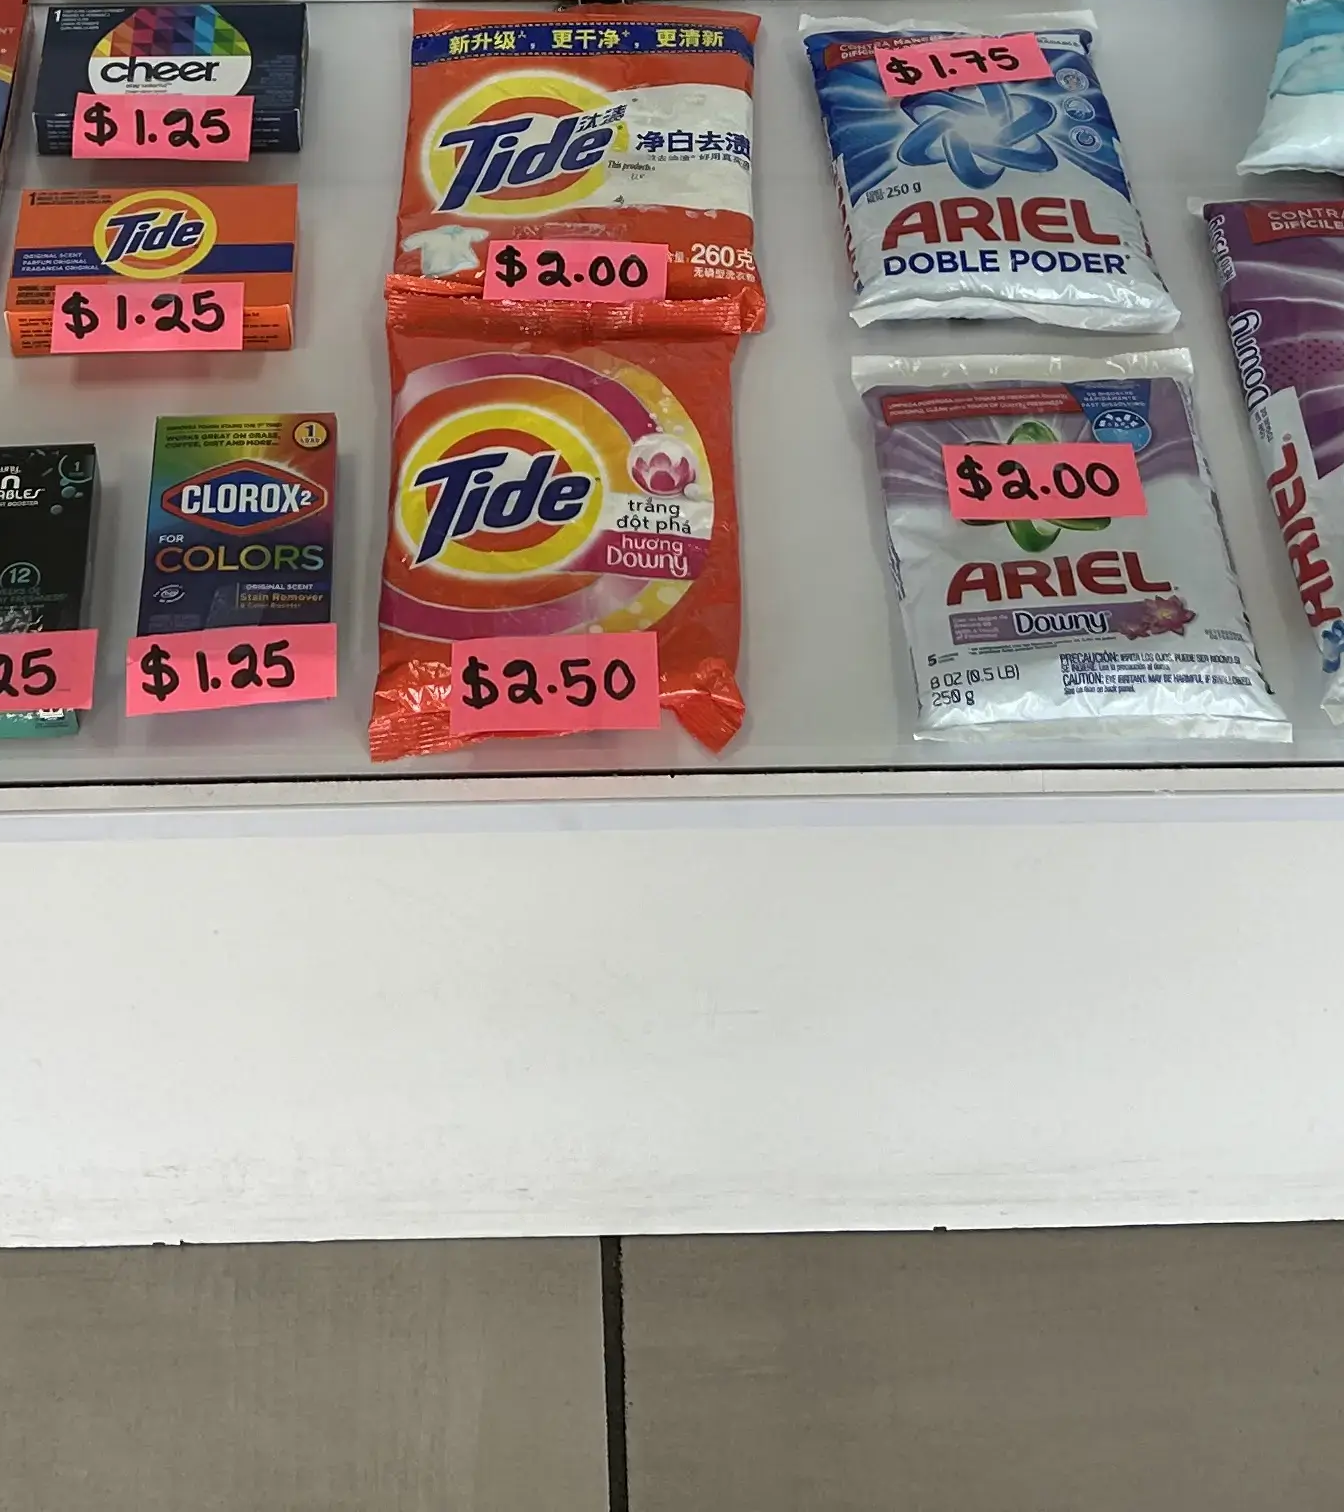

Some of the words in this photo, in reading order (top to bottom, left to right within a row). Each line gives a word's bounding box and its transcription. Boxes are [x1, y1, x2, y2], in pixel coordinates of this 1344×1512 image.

[101, 57, 217, 82] cheer
[886, 46, 1019, 86] $1.75
[83, 102, 231, 149] $1.25
[436, 116, 613, 213] Tide
[102, 211, 204, 264] Tide
[882, 196, 1120, 250] ARIEL
[495, 245, 649, 287] $2.00
[884, 249, 1000, 276] DOBLE
[1011, 251, 1127, 274] PODER
[61, 290, 225, 339] $1.25
[956, 454, 1120, 501] $2.00
[413, 452, 591, 564] Tide
[616, 514, 649, 531] đột
[656, 516, 692, 535] phá
[628, 497, 680, 518] trắng
[159, 535, 184, 543] FOR
[622, 535, 683, 555] hương
[1269, 441, 1344, 628] ARIEL
[155, 545, 324, 572] COLORS
[607, 546, 689, 577] Downy
[947, 550, 1172, 606] ARIEL
[1014, 611, 1106, 635] Downy
[140, 639, 295, 701] $1.25
[461, 655, 636, 709] $2.50
